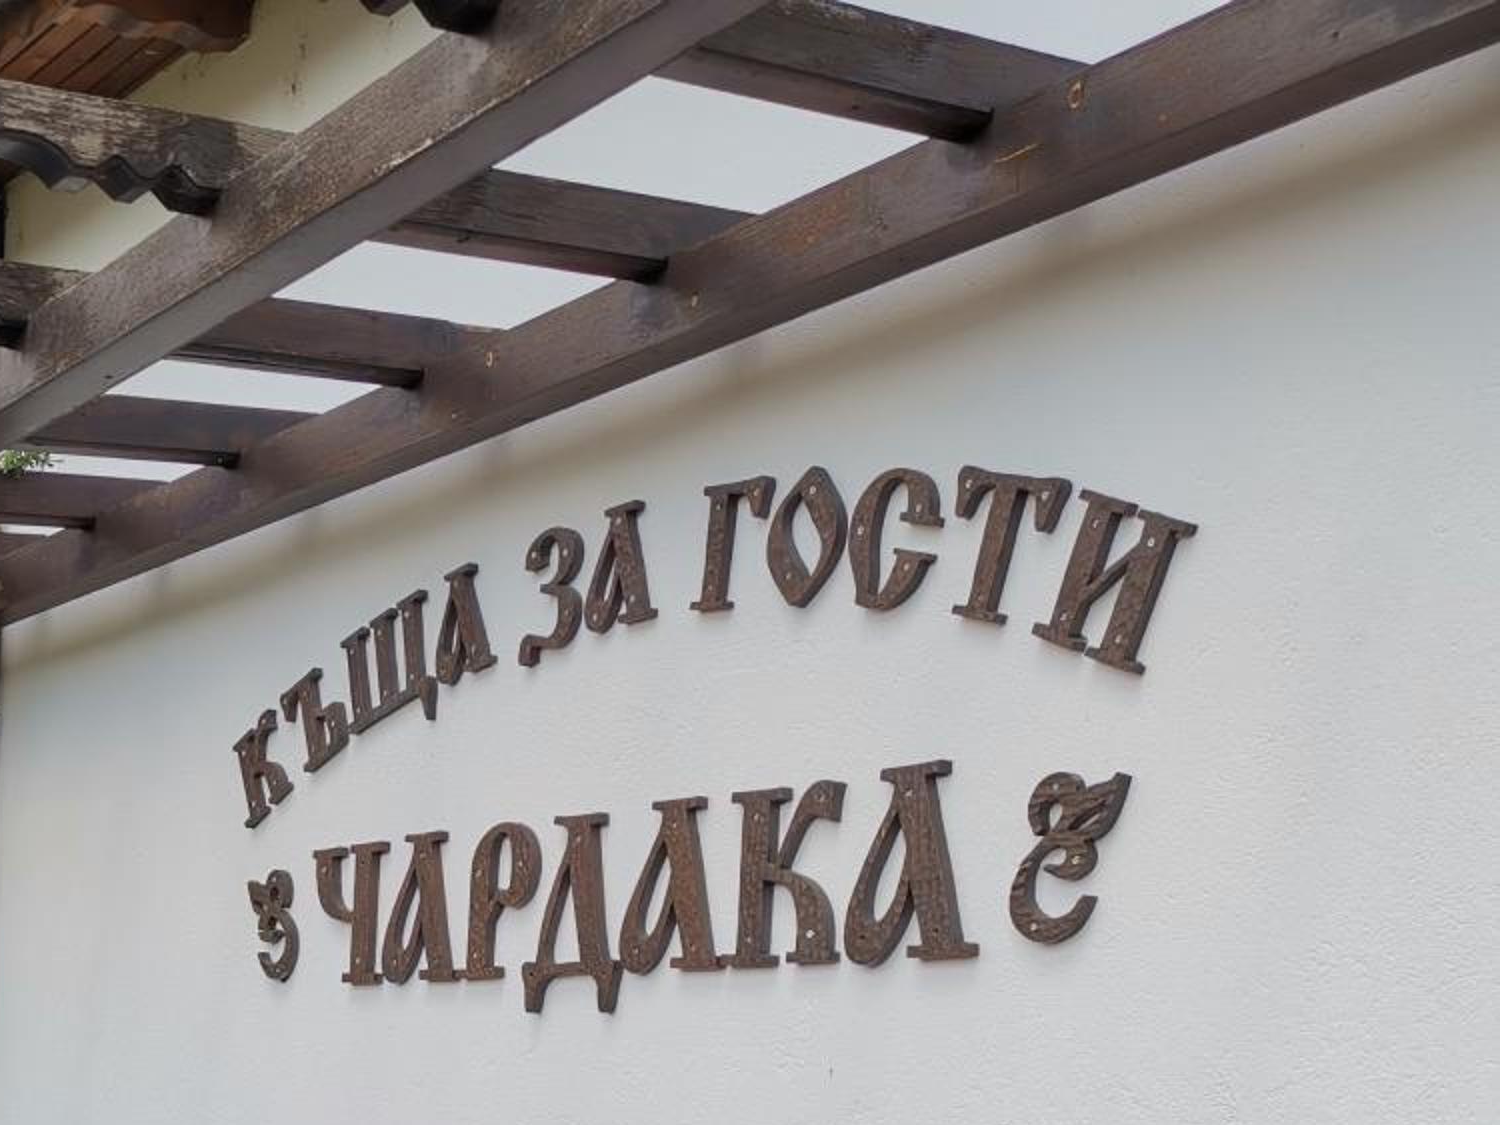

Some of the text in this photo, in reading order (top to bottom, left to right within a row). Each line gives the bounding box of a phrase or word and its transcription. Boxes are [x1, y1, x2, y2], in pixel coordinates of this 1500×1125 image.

[232, 464, 1200, 830] КЪЩА ЗА ГОСТИ
[312, 758, 981, 1016] ЧАРДАКА
